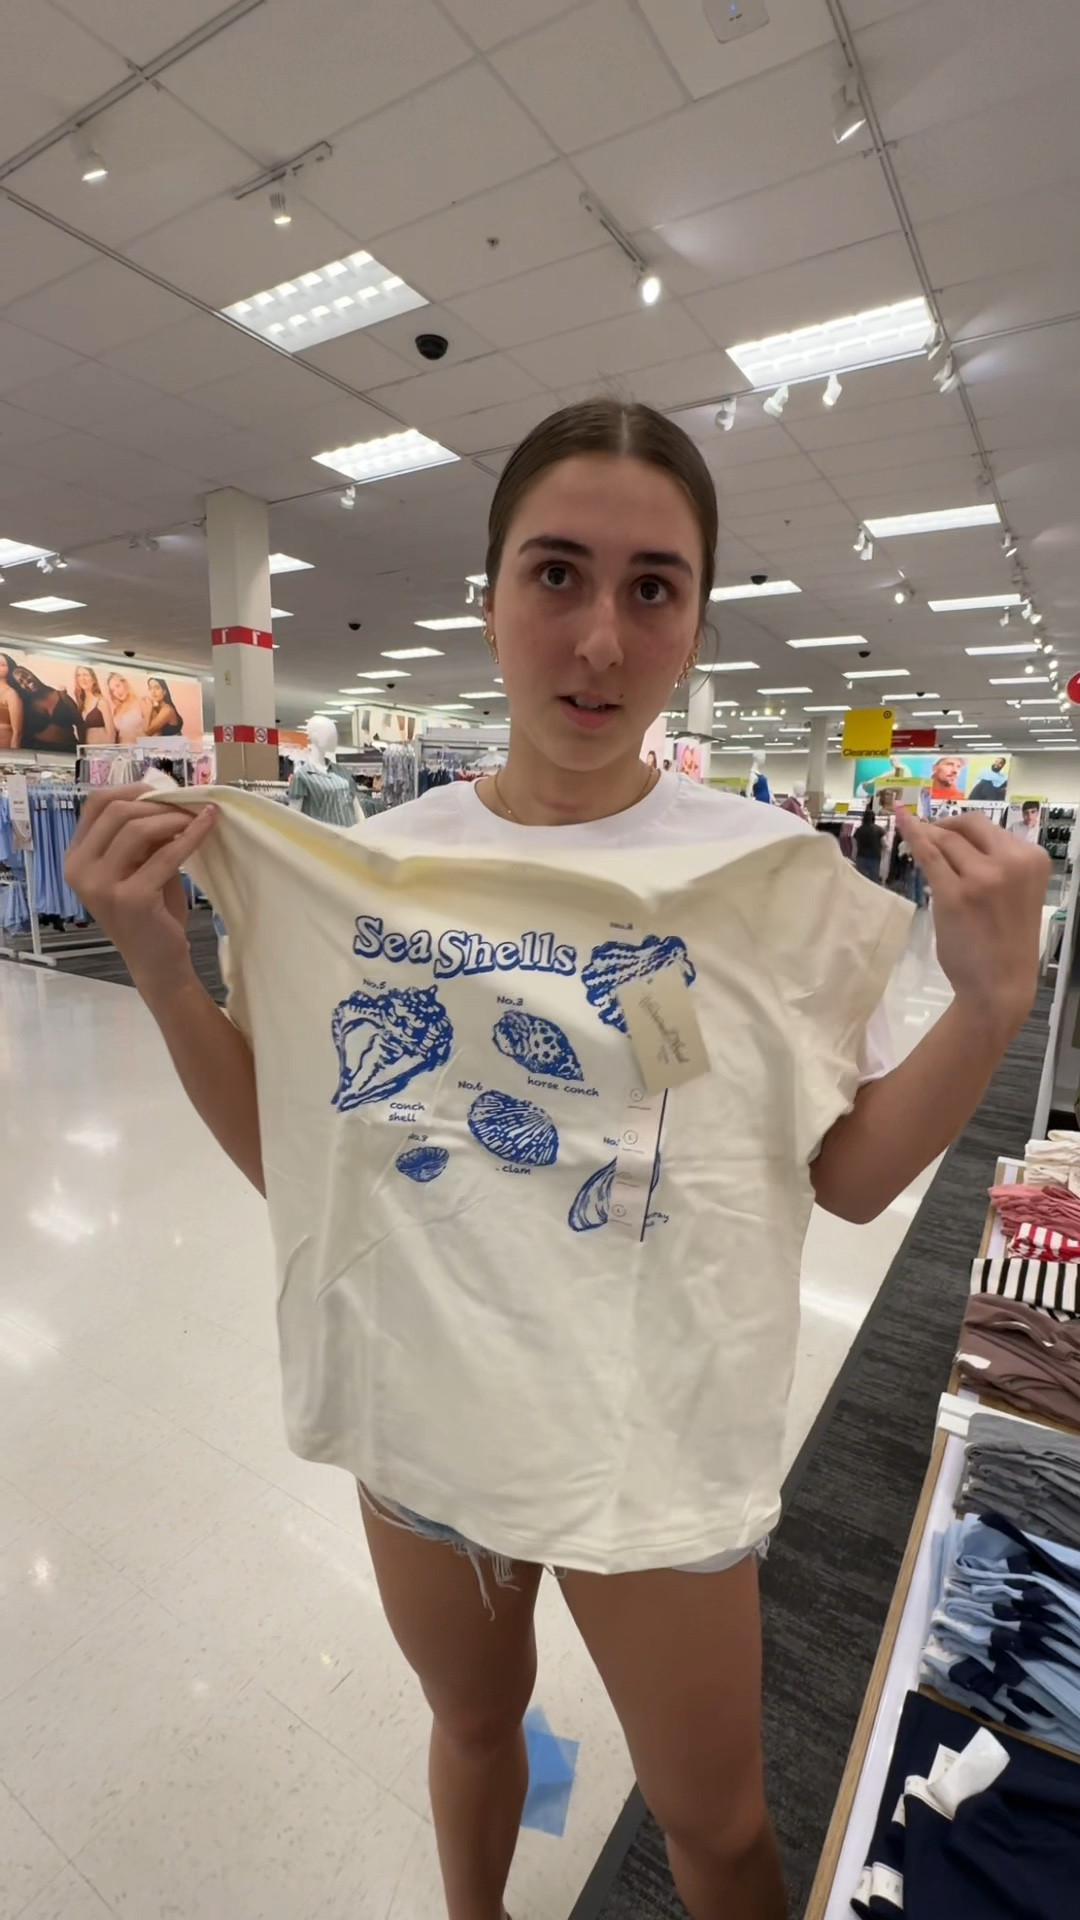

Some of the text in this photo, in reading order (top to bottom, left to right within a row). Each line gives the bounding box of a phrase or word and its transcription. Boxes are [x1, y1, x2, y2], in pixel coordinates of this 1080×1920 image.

[353, 915, 577, 979] Sea Shells
[458, 1080, 483, 1091] No.6
[527, 1076, 599, 1097] horse conch
[390, 1102, 424, 1111] conch
[388, 1112, 416, 1122] shell
[603, 1136, 621, 1147] No.
[502, 1164, 531, 1175] clam
